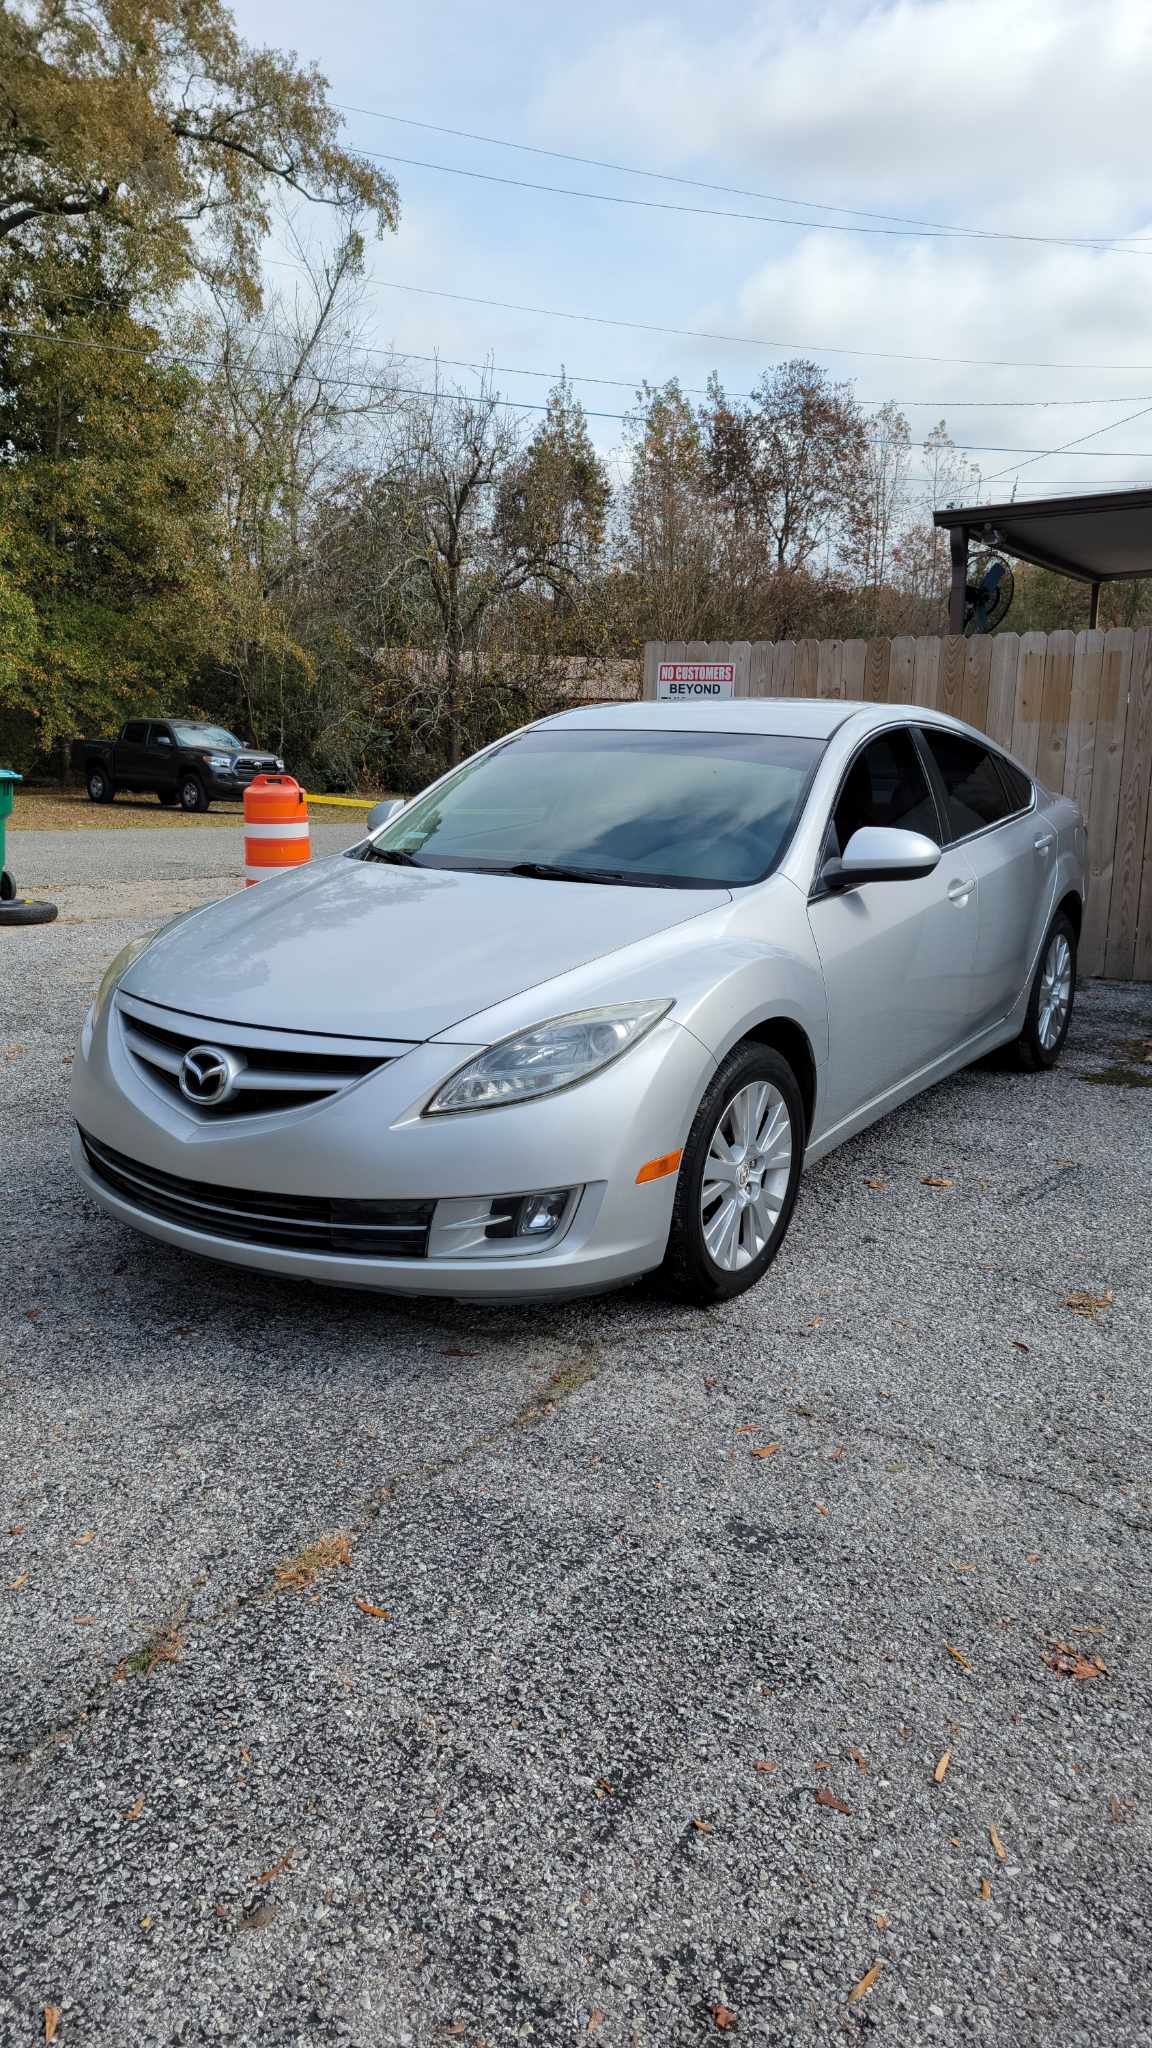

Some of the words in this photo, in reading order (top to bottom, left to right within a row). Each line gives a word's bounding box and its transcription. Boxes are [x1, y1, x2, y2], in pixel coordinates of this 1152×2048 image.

[661, 666, 674, 680] NO
[675, 666, 732, 680] CUSTOMERS
[669, 683, 721, 694] BEYOND
